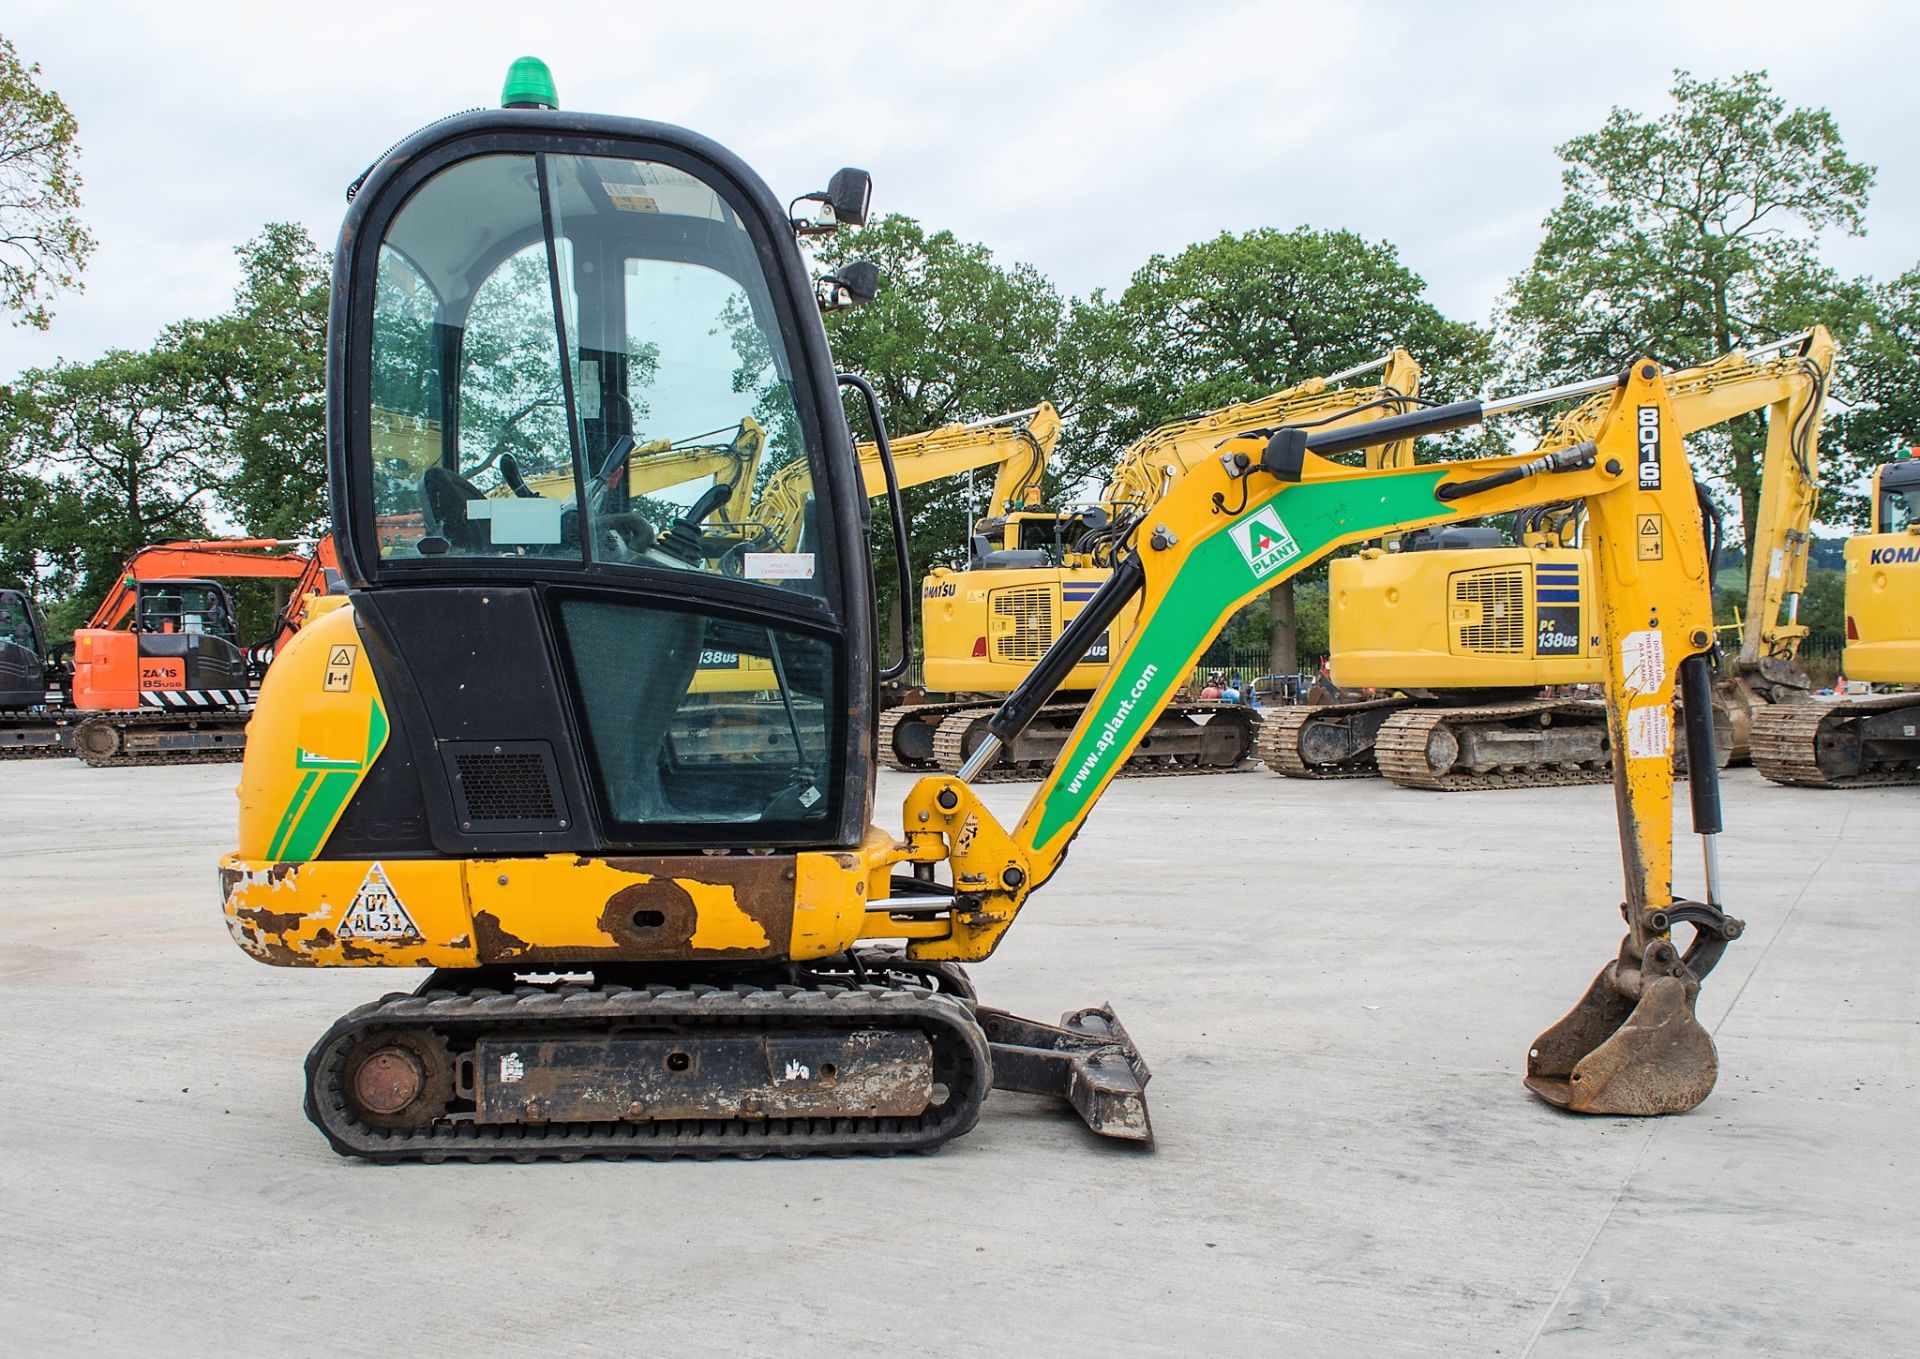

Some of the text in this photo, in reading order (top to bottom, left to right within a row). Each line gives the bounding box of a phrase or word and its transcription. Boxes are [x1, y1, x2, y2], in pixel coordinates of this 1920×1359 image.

[1639, 408, 1660, 480] 8016
[1249, 520, 1286, 560] A
[1252, 541, 1296, 574] PLANT
[1539, 620, 1555, 631] PC
[1067, 663, 1159, 794] www.aplant.com
